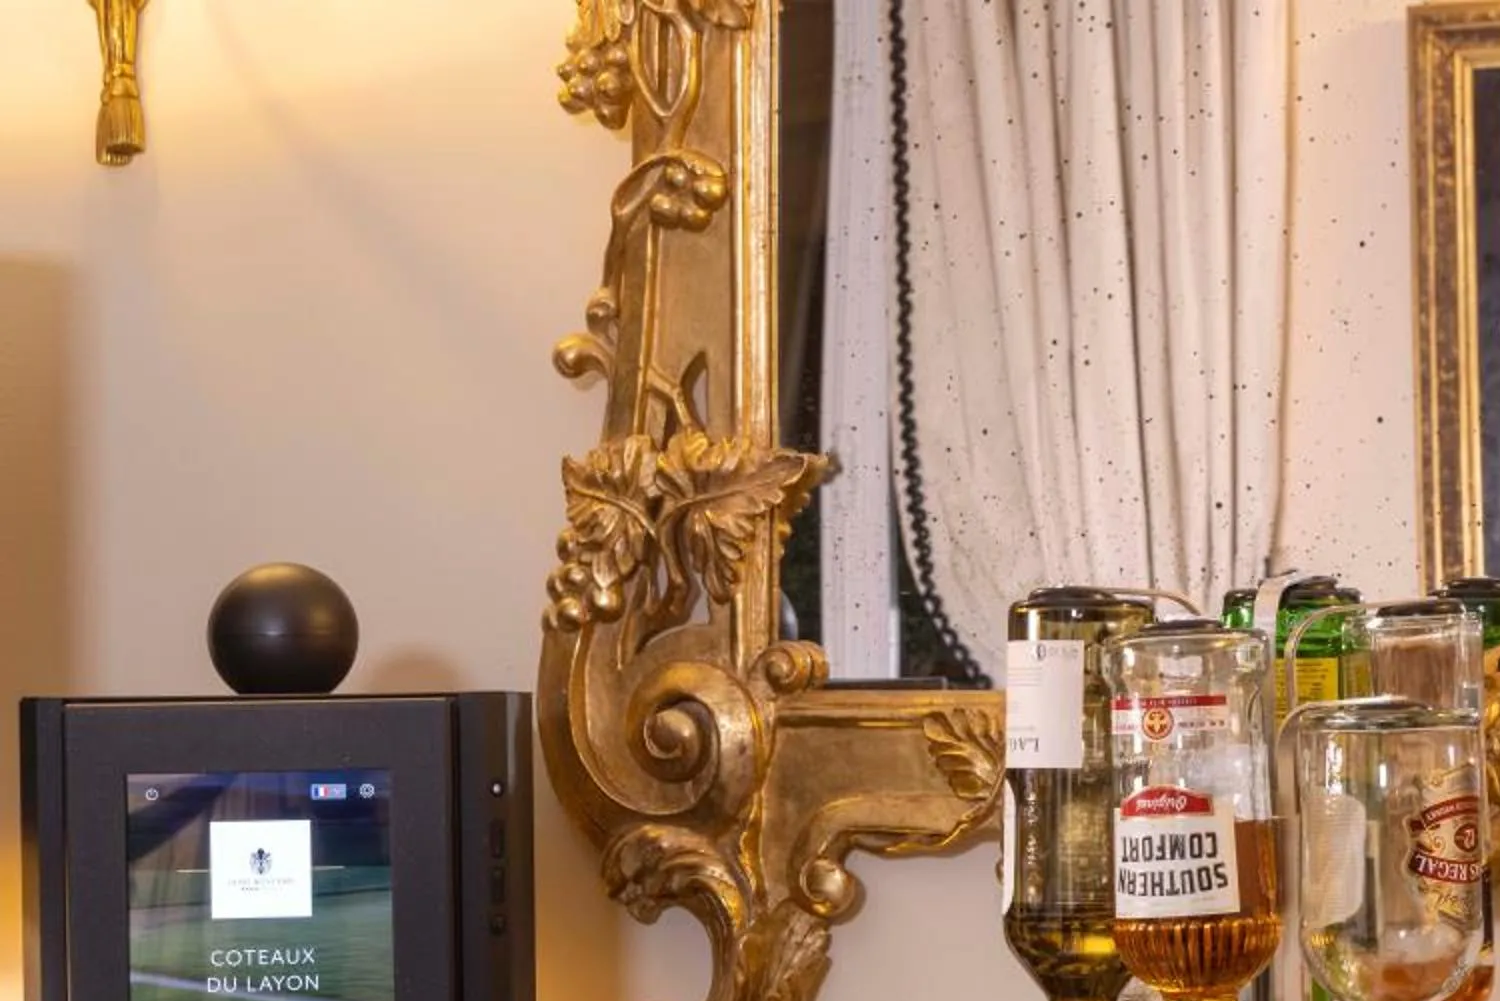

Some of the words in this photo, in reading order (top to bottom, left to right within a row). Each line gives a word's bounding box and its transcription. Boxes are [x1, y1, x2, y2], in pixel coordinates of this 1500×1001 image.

[1120, 831, 1219, 862] COMFORT
[1116, 861, 1229, 899] SOUTHERN
[1414, 853, 1468, 881] REGAL
[211, 948, 316, 967] COTEAUX
[207, 977, 238, 993] DU
[246, 975, 320, 992] LAYON
